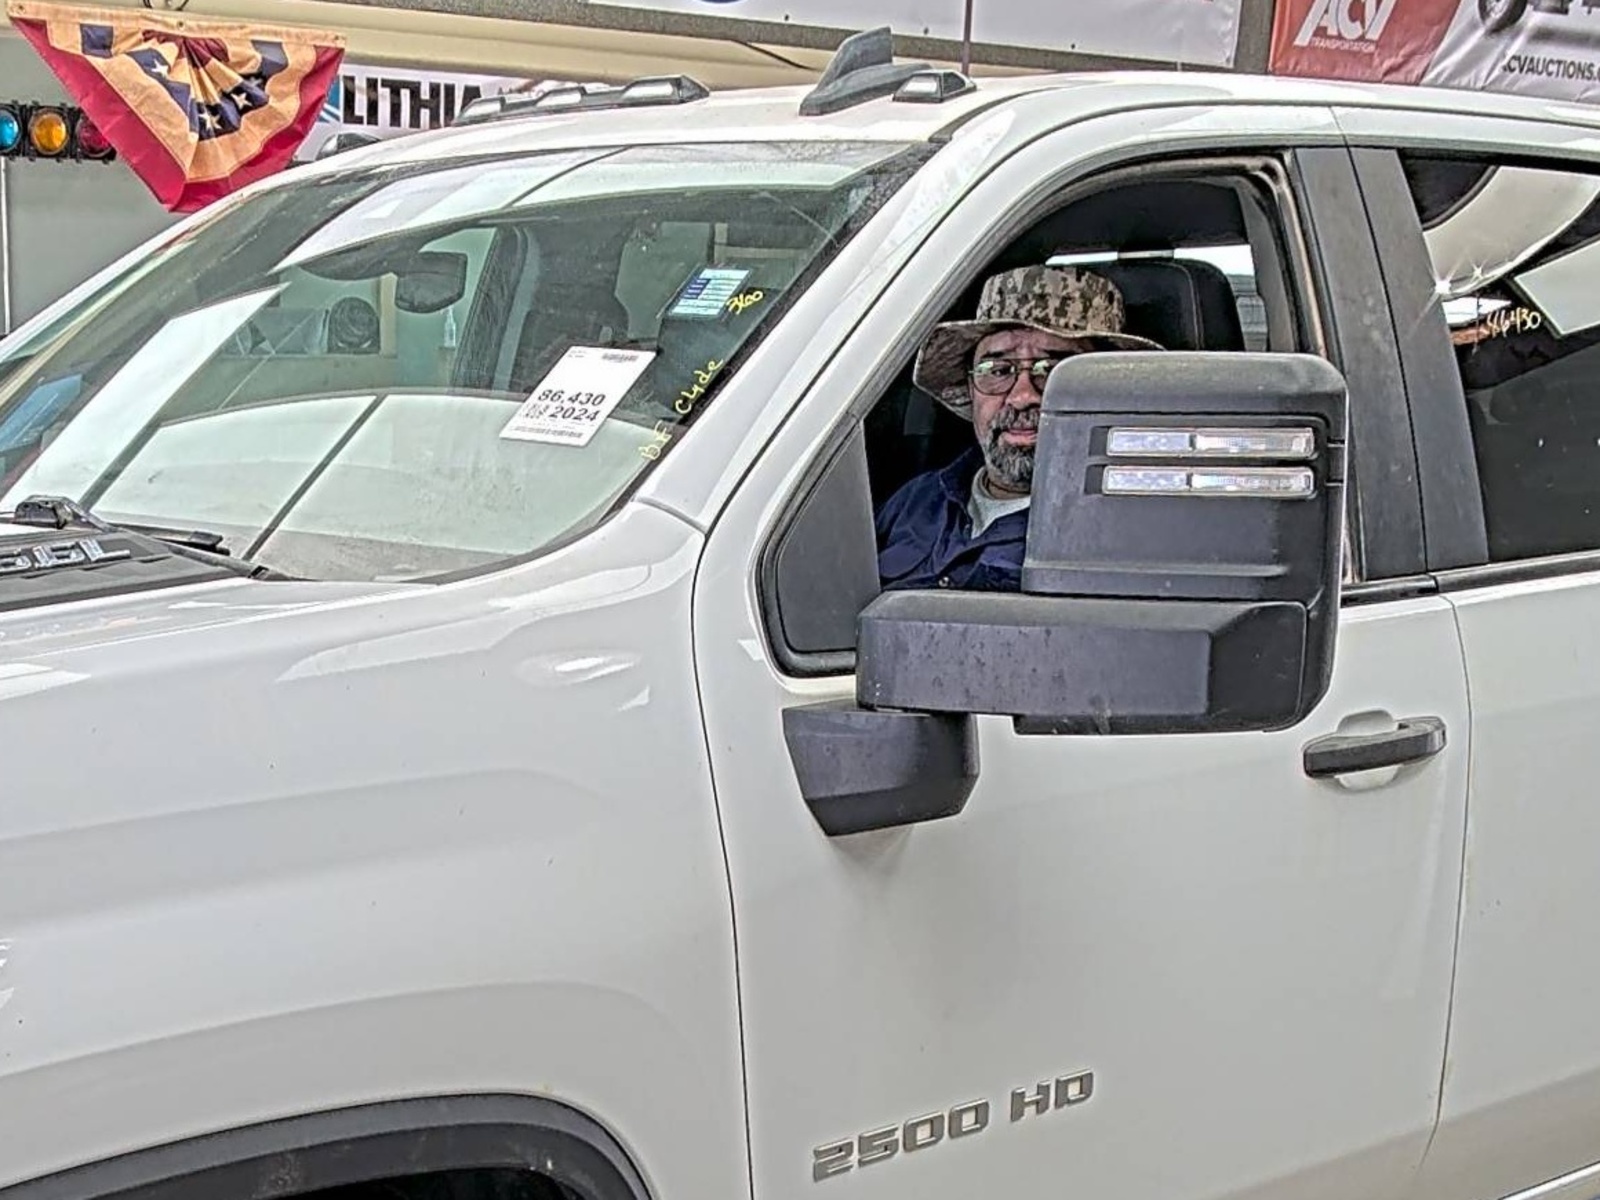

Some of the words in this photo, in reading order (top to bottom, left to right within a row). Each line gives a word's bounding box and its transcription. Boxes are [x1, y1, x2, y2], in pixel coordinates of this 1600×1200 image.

[1293, 0, 1397, 47] ACV
[1502, 54, 1600, 84] CVAUCTIONS.
[675, 358, 724, 414] Clyde
[548, 405, 601, 422] 2024
[813, 1098, 990, 1183] 2500
[1010, 1068, 1095, 1123] HD
